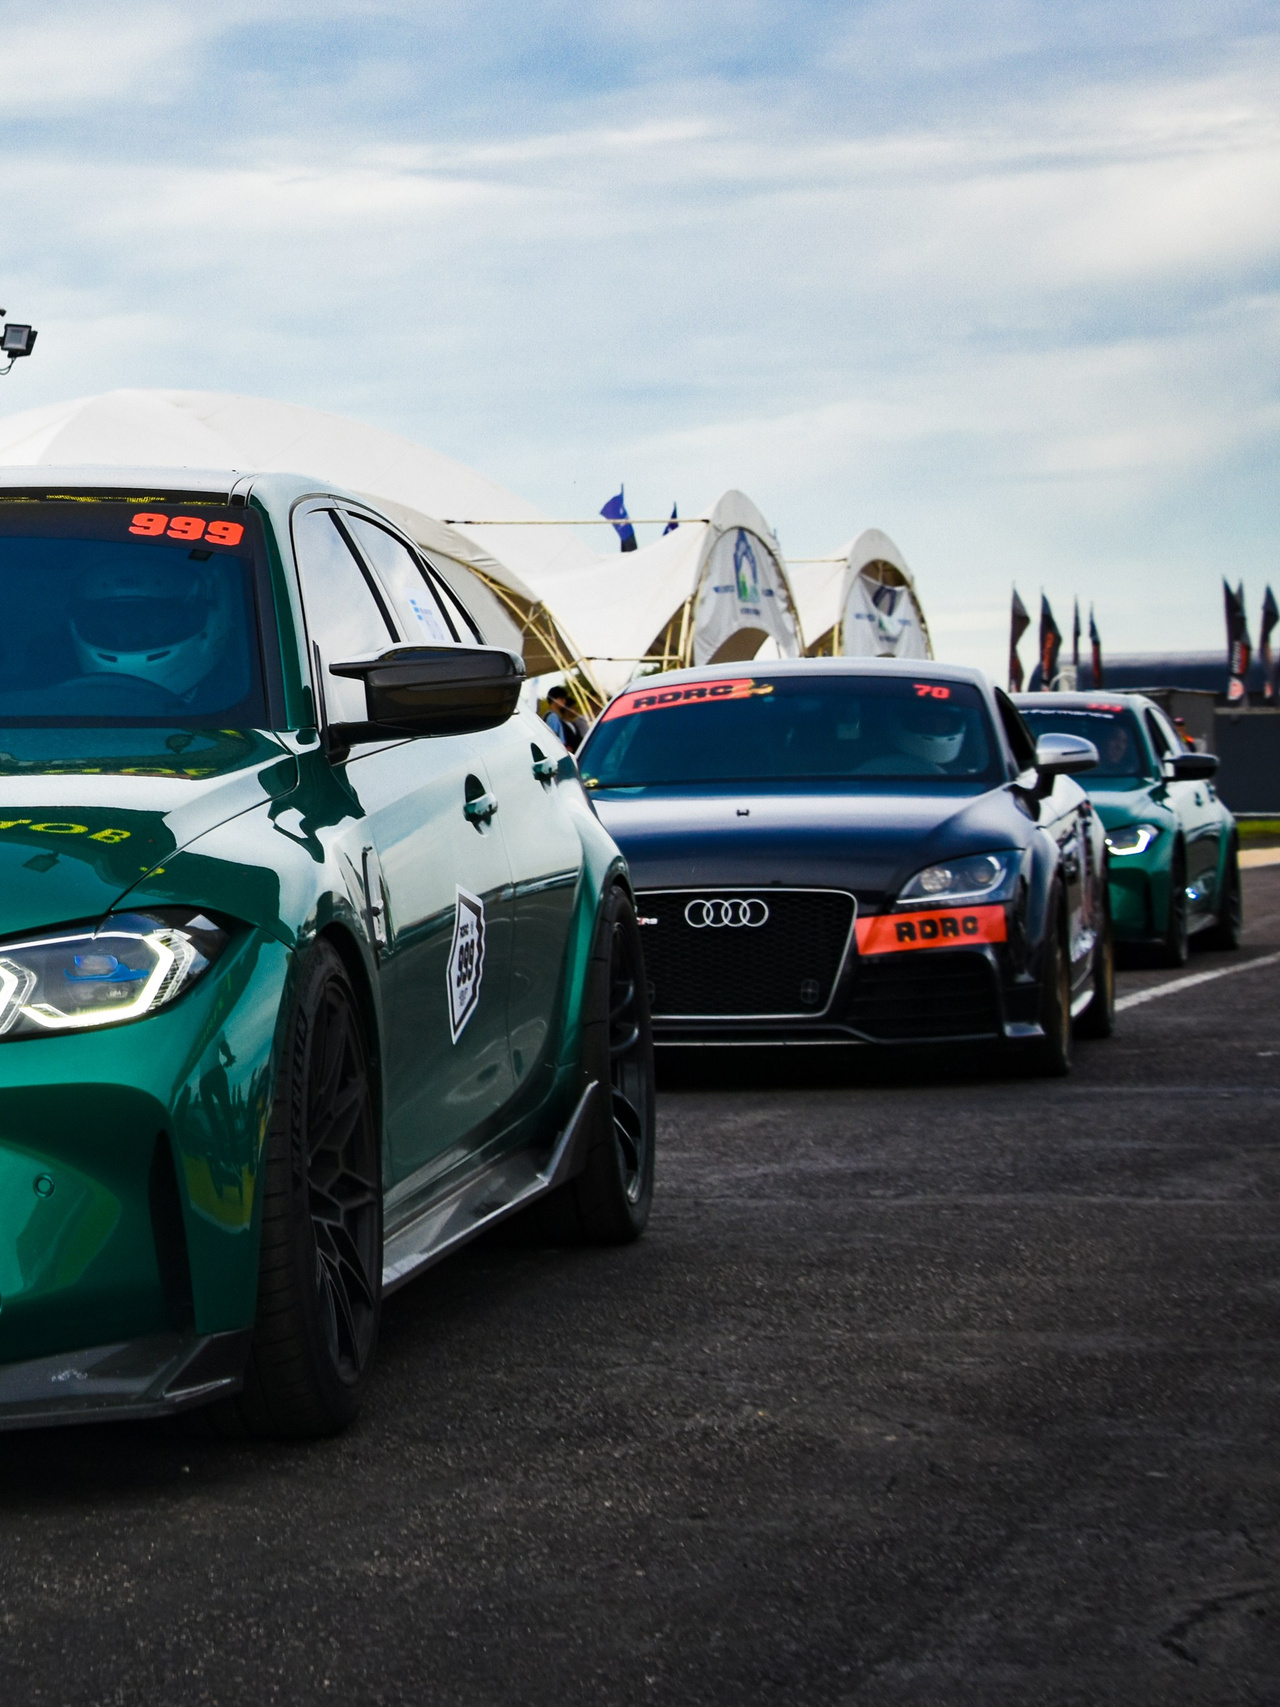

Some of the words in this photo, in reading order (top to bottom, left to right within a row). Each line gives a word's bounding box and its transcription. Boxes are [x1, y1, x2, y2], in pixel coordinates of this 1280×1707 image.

[128, 511, 245, 546] 999
[632, 684, 735, 709] RDRC
[913, 683, 952, 699] 70
[894, 915, 979, 943] RDRC
[456, 938, 475, 988] 999
